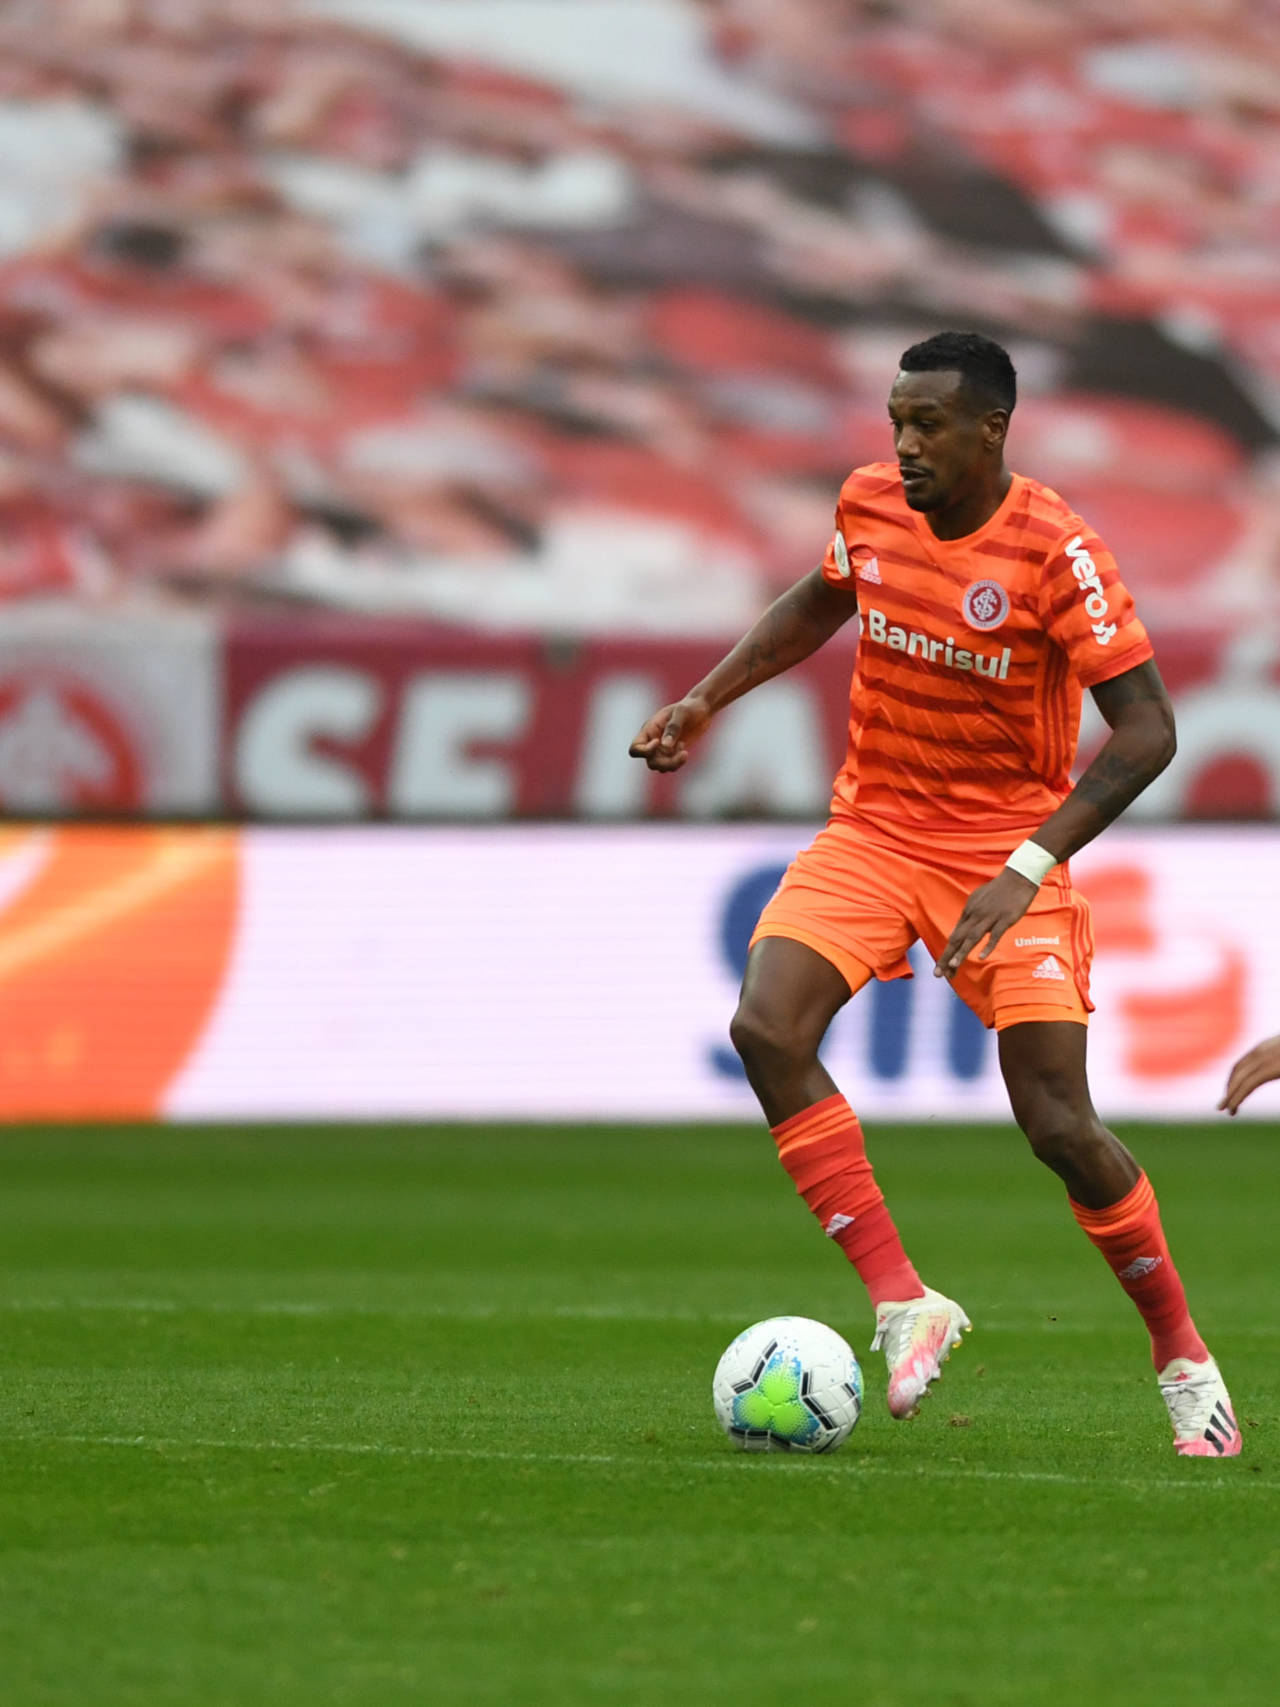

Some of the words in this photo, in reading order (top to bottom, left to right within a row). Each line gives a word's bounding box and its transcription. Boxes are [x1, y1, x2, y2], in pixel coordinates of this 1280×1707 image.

[1065, 535, 1108, 619] vero
[868, 607, 1012, 680] Banrisul
[1013, 935, 1061, 948] Unimed
